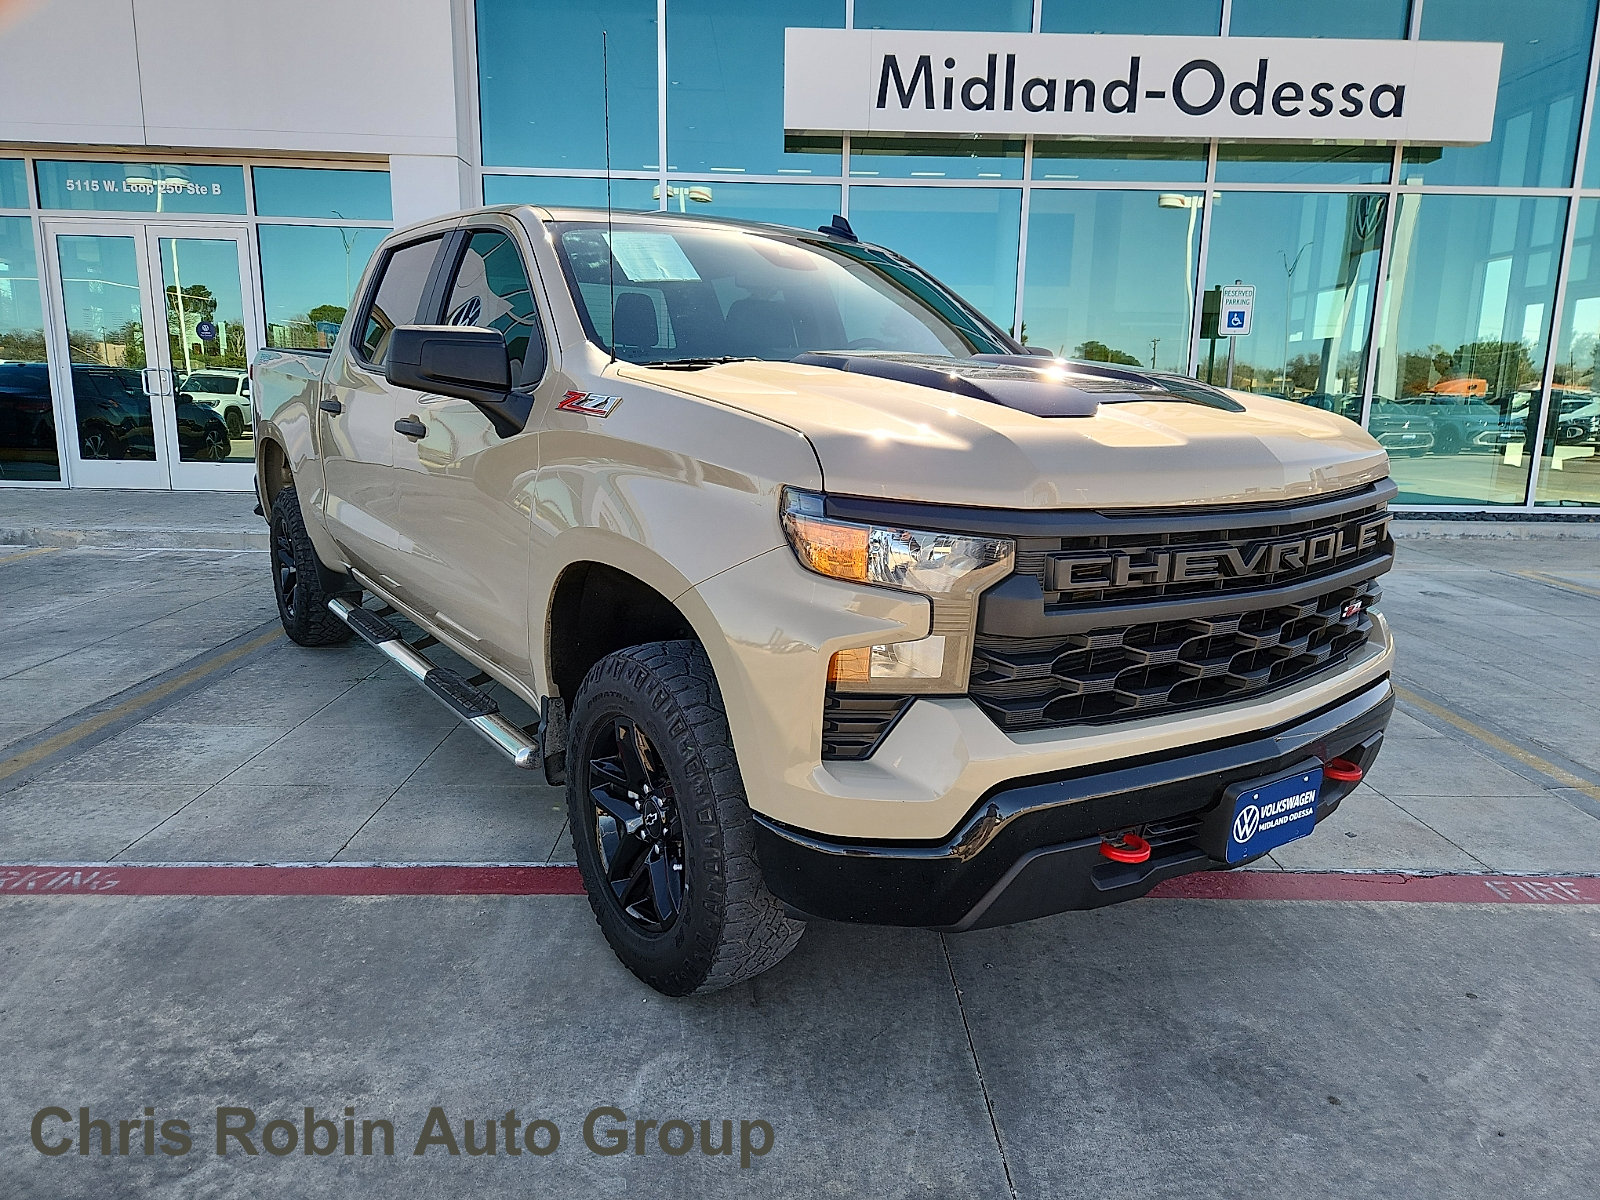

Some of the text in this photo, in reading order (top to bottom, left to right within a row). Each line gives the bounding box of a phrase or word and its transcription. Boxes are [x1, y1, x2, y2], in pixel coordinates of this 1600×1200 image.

[874, 53, 1406, 119] Midland-Odessa
[66, 179, 222, 195] 5115 W. Loop 250 Ste B
[555, 390, 623, 418] Z71
[1052, 514, 1394, 591] CHEVROLET
[1260, 790, 1316, 819] VOLKSWAGEN
[1258, 807, 1313, 833] MIDLAND ODESSA
[1485, 880, 1596, 901] FIRE
